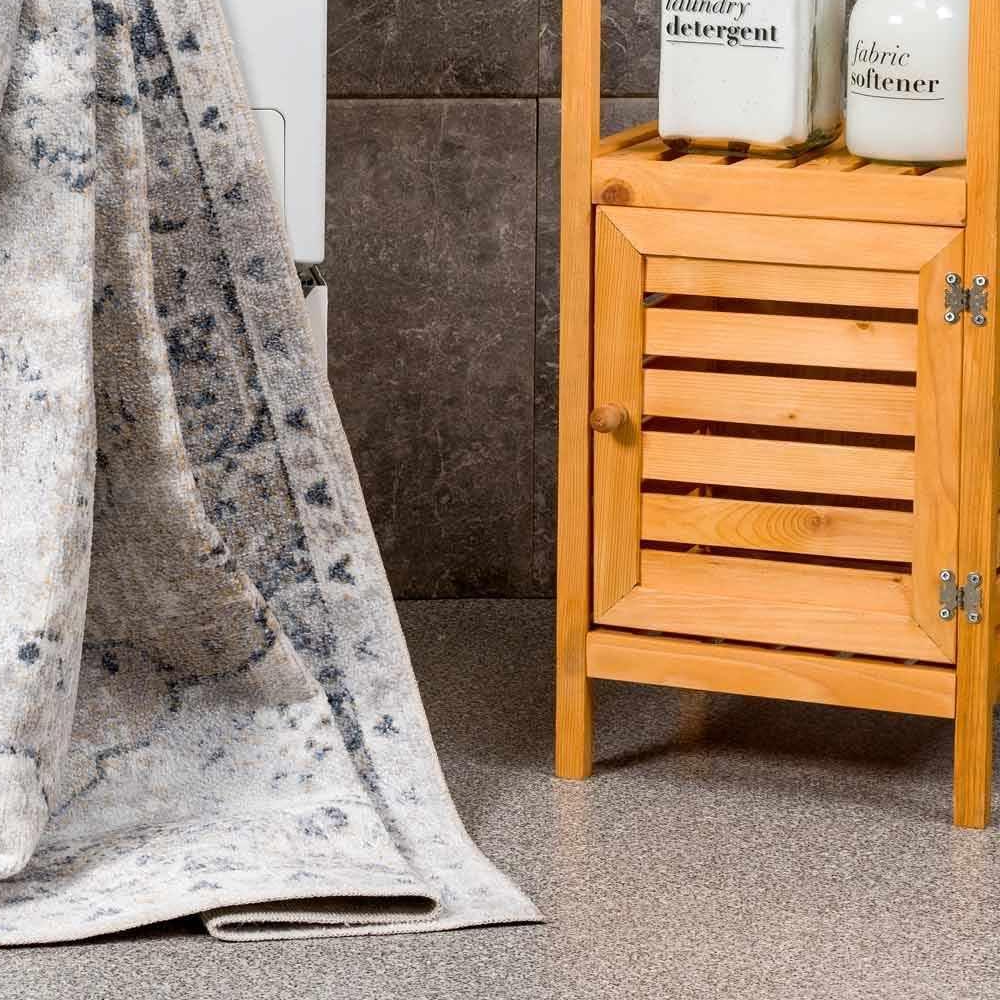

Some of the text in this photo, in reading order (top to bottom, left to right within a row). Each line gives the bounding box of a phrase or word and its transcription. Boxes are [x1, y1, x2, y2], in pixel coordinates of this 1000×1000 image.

[665, 15, 777, 47] detergent
[851, 39, 911, 68] fabric
[850, 68, 940, 94] softener
